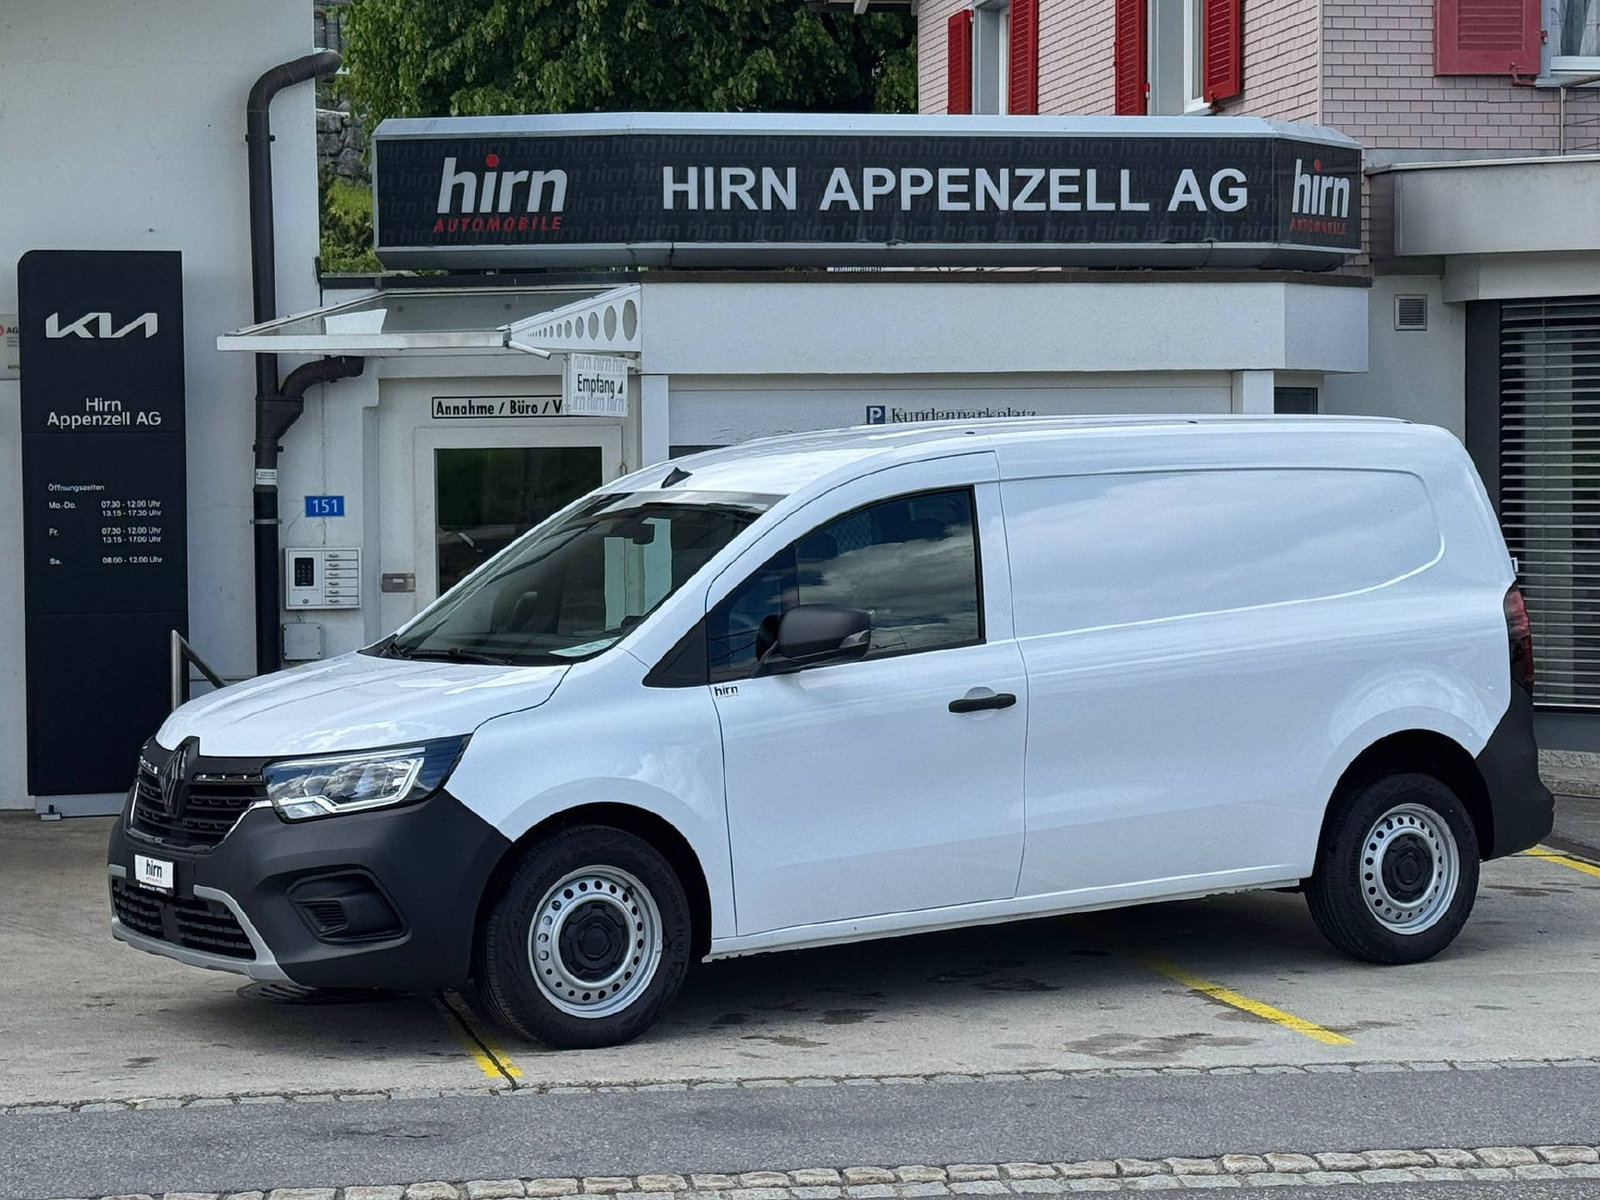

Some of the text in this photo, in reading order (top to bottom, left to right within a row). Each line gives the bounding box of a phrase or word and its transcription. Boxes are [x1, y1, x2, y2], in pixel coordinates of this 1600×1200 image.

[437, 154, 568, 213] hirn
[663, 166, 1248, 212] HIRN APPENZELL AG
[1292, 158, 1350, 218] hirn
[433, 216, 562, 233] AUTOMOBILE
[46, 312, 158, 339] KIA
[577, 373, 615, 400] Empfang
[86, 398, 122, 412] Hirn
[436, 400, 495, 416] Annahme
[509, 399, 538, 415] Büro
[552, 399, 563, 414] V
[47, 412, 162, 429] Appenzell AG
[148, 500, 161, 508] Uhr
[312, 499, 338, 513] 151
[714, 685, 738, 697] hirn
[146, 859, 162, 878] hirn
